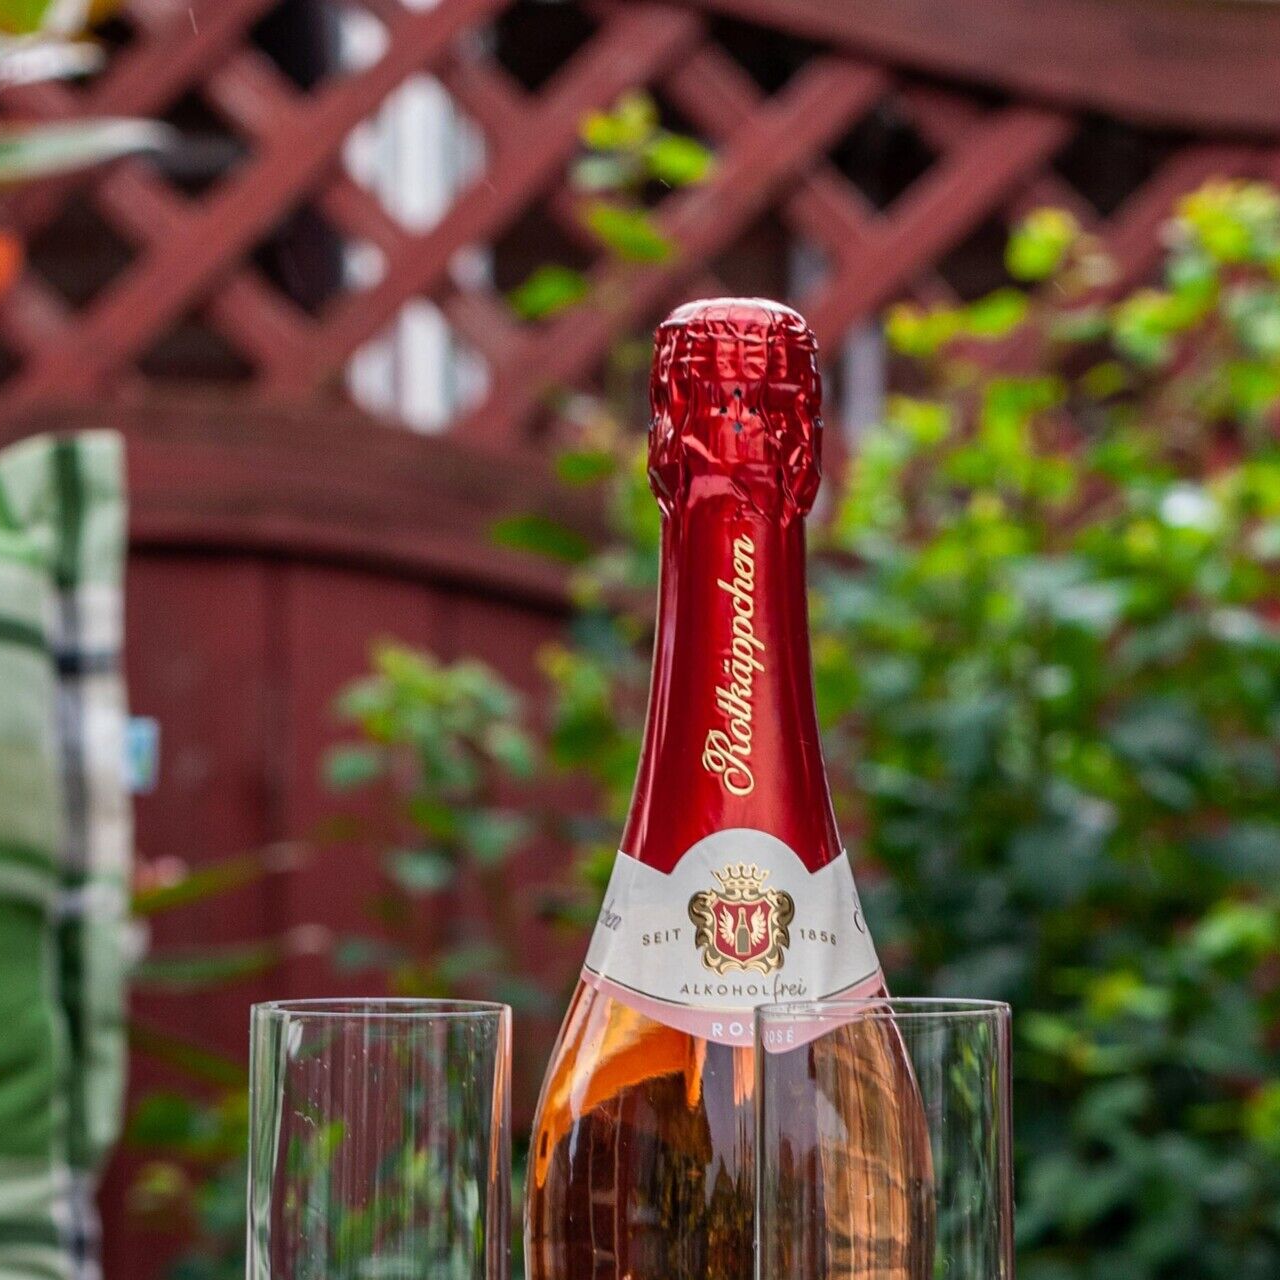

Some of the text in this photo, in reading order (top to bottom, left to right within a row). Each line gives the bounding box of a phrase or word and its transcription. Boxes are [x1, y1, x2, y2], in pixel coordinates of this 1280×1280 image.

[702, 533, 765, 797] Rotkäppchen
[642, 928, 837, 946] SEIT 1856
